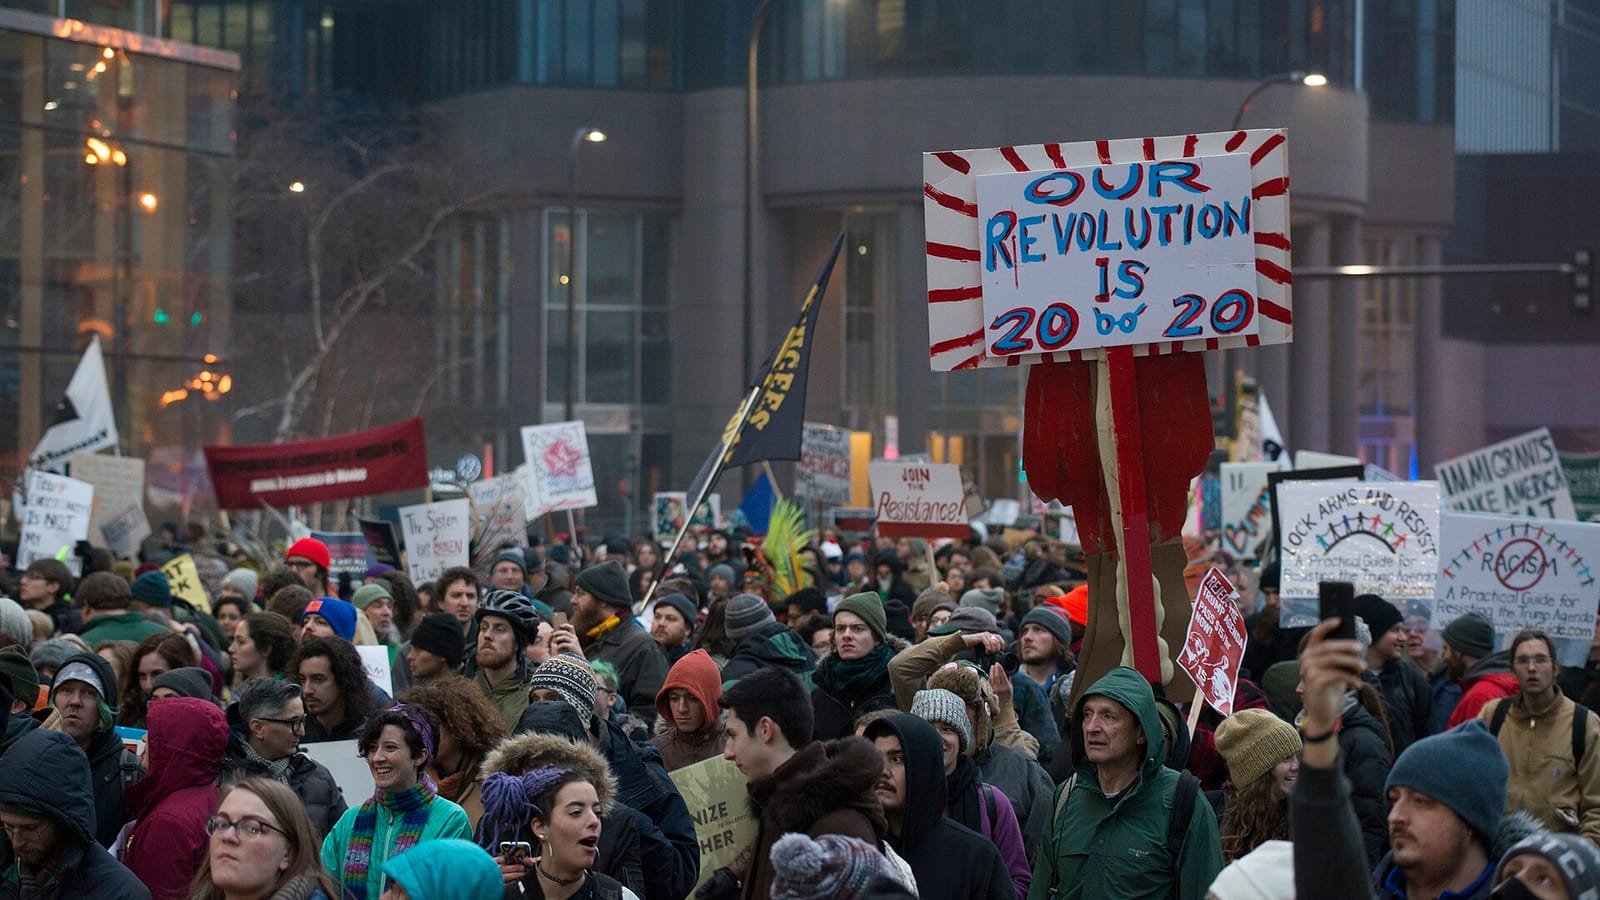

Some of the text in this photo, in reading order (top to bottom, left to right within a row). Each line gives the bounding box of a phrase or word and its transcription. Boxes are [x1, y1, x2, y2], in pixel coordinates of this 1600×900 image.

[1024, 160, 1212, 206] OUR
[986, 196, 1251, 274] REVOLUTION
[1095, 257, 1149, 302] IS
[989, 289, 1254, 355] 20 20
[902, 468, 930, 482] JOIN
[1440, 435, 1554, 496] IMMIGRANTS
[907, 483, 925, 491] THE
[1503, 466, 1566, 508] AMERICA
[876, 491, 966, 522] Resistance!
[403, 513, 422, 536] The
[1282, 513, 1318, 556] LOCK
[1318, 488, 1359, 520] ARMS
[1365, 489, 1395, 511] AND
[1362, 554, 1395, 568] Guide
[1481, 552, 1559, 577] RACISM
[1207, 575, 1229, 607] REJEC
[1446, 586, 1581, 608] A Practical Guide for
[1195, 611, 1213, 637] NOW!
[1198, 600, 1215, 624] PASS
[1202, 585, 1243, 649] TRUMP AGENDA
[1498, 605, 1515, 618] the
[1516, 604, 1551, 621] Trump
[1553, 608, 1595, 626] Agenda
[701, 830, 735, 855] HER
